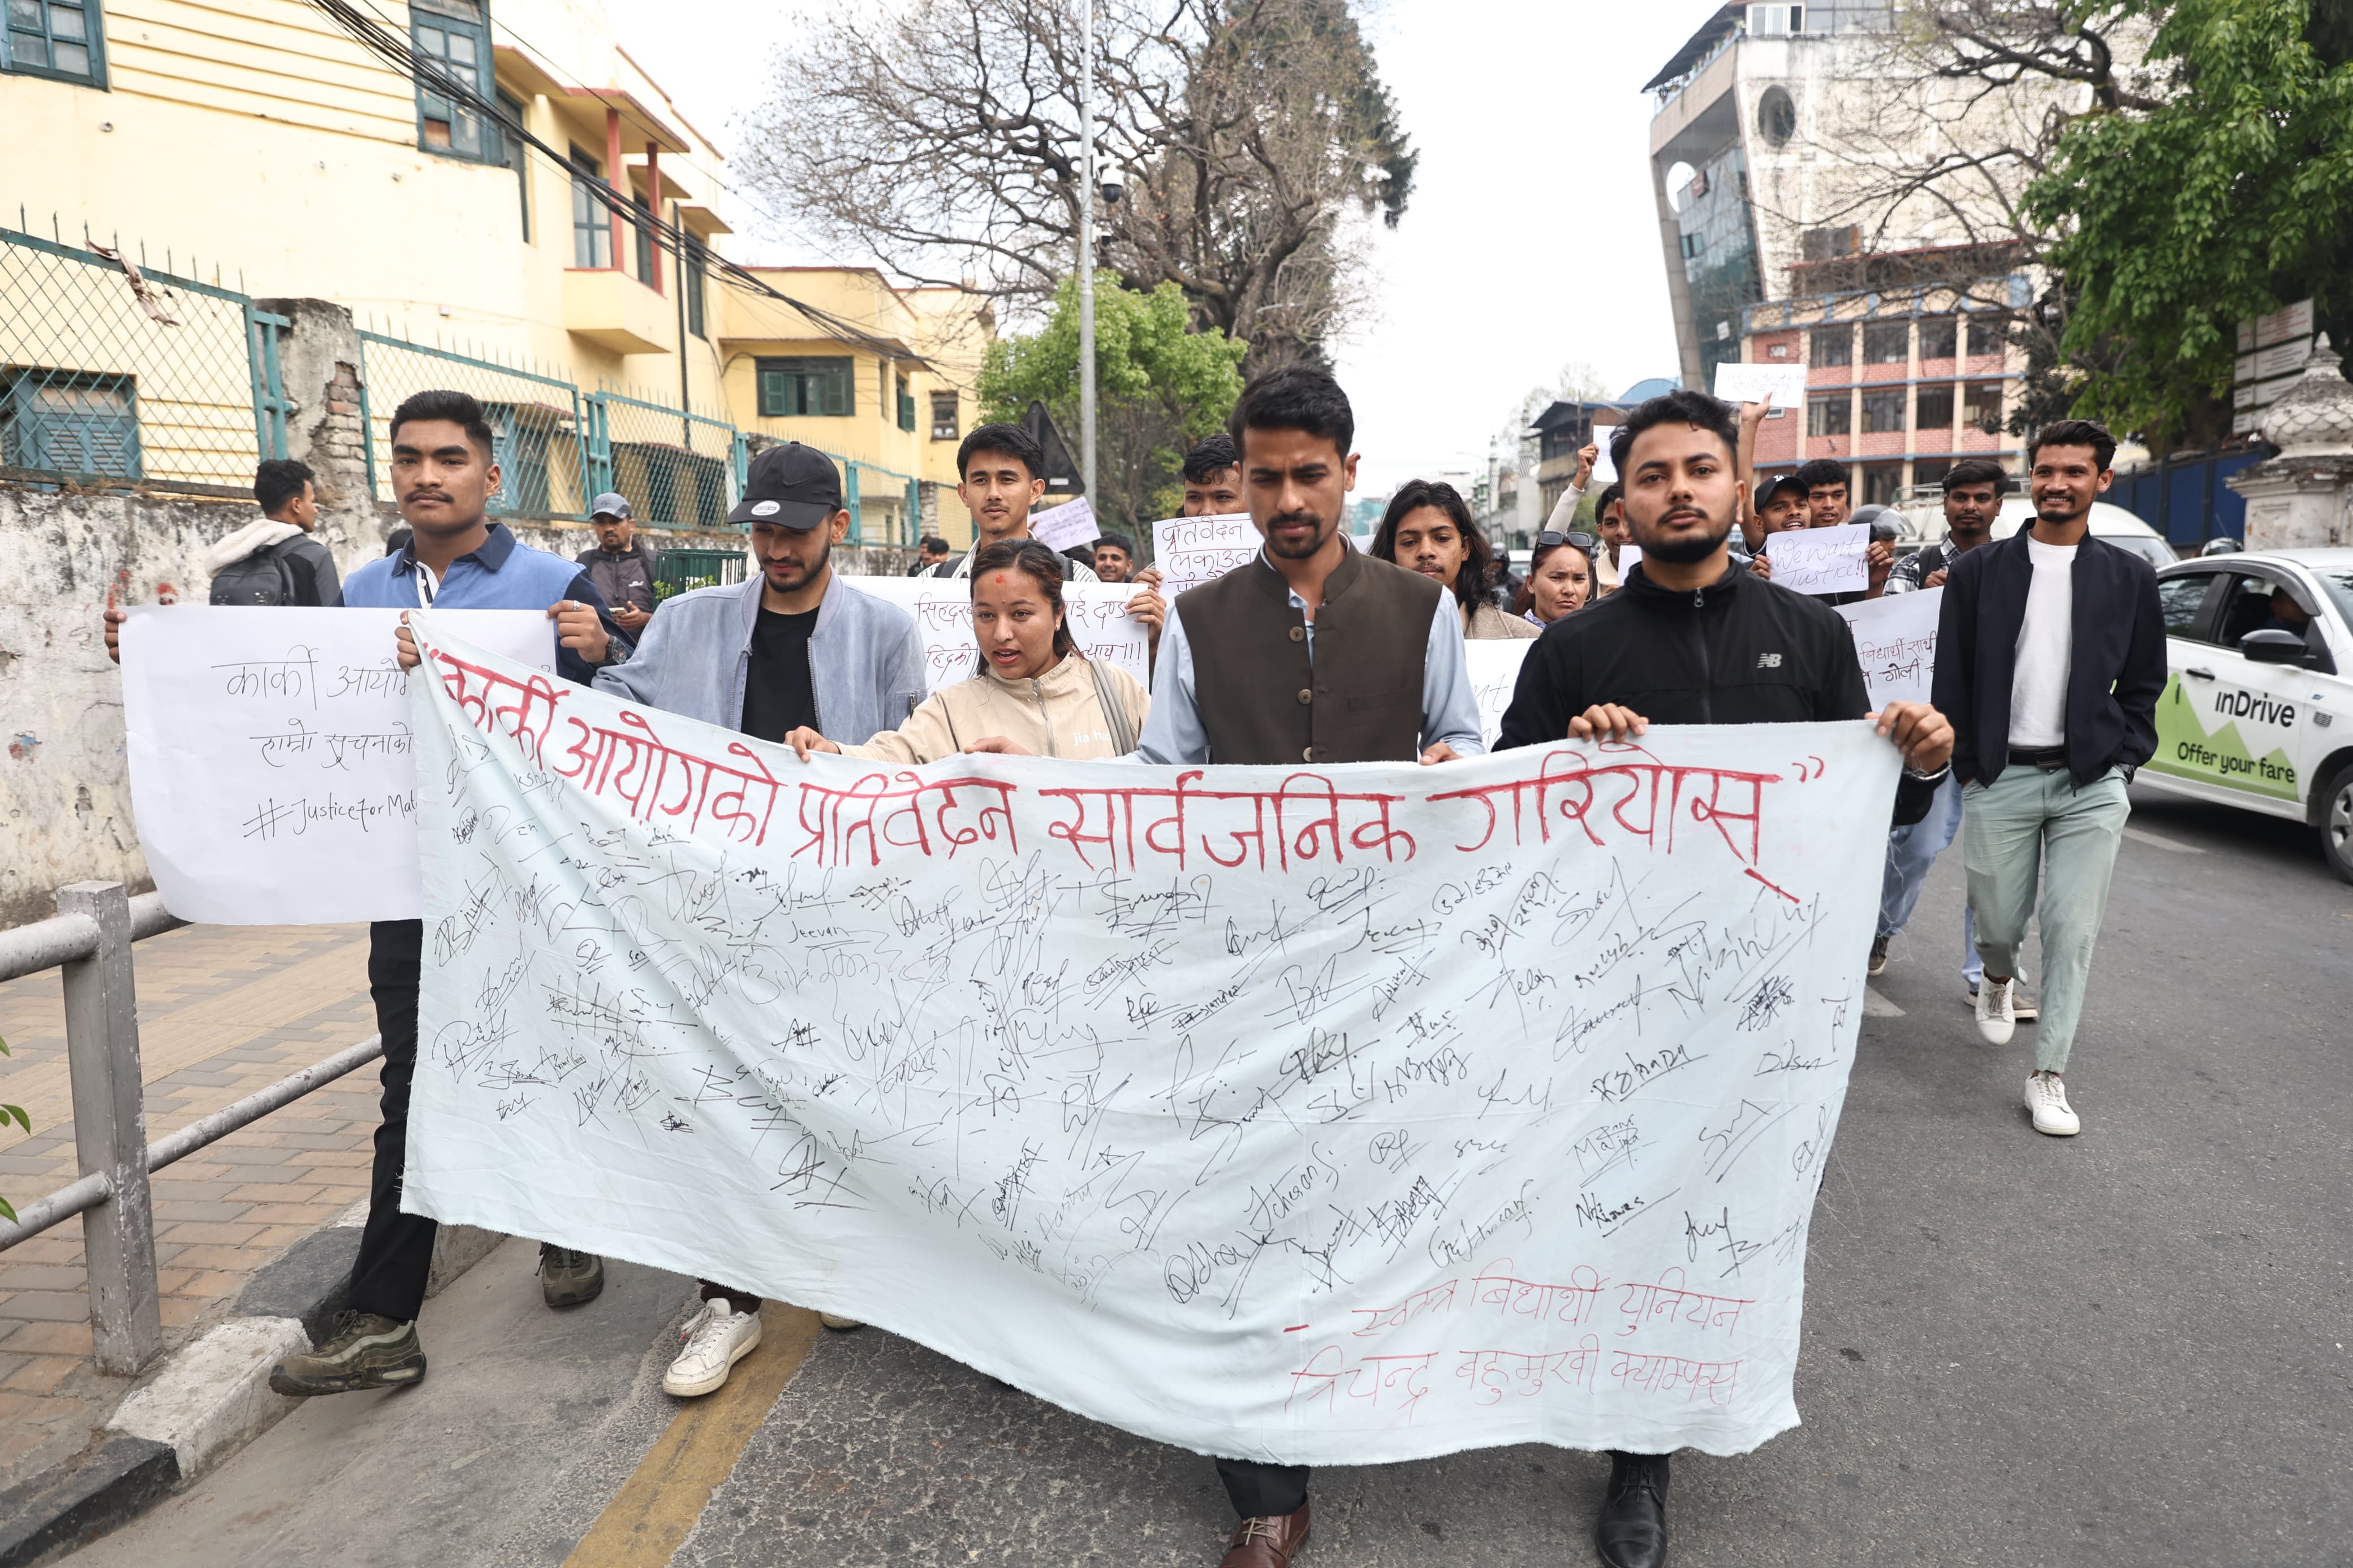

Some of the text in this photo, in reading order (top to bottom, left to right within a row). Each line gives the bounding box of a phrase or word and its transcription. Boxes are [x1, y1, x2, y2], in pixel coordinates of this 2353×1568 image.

[1775, 531, 1864, 569] We want
[1782, 558, 1865, 589] Justice!!
[211, 644, 320, 711] कार्की
[2214, 690, 2295, 728] inDrive
[2177, 741, 2295, 784] Offer your fare
[243, 789, 418, 841] #JusticeforMat
[553, 710, 787, 847] आयोगको
[791, 771, 1018, 868] प्रतिवेदन
[1038, 770, 1416, 874] सार्वजनिक
[1614, 1266, 1756, 1337] युनियन
